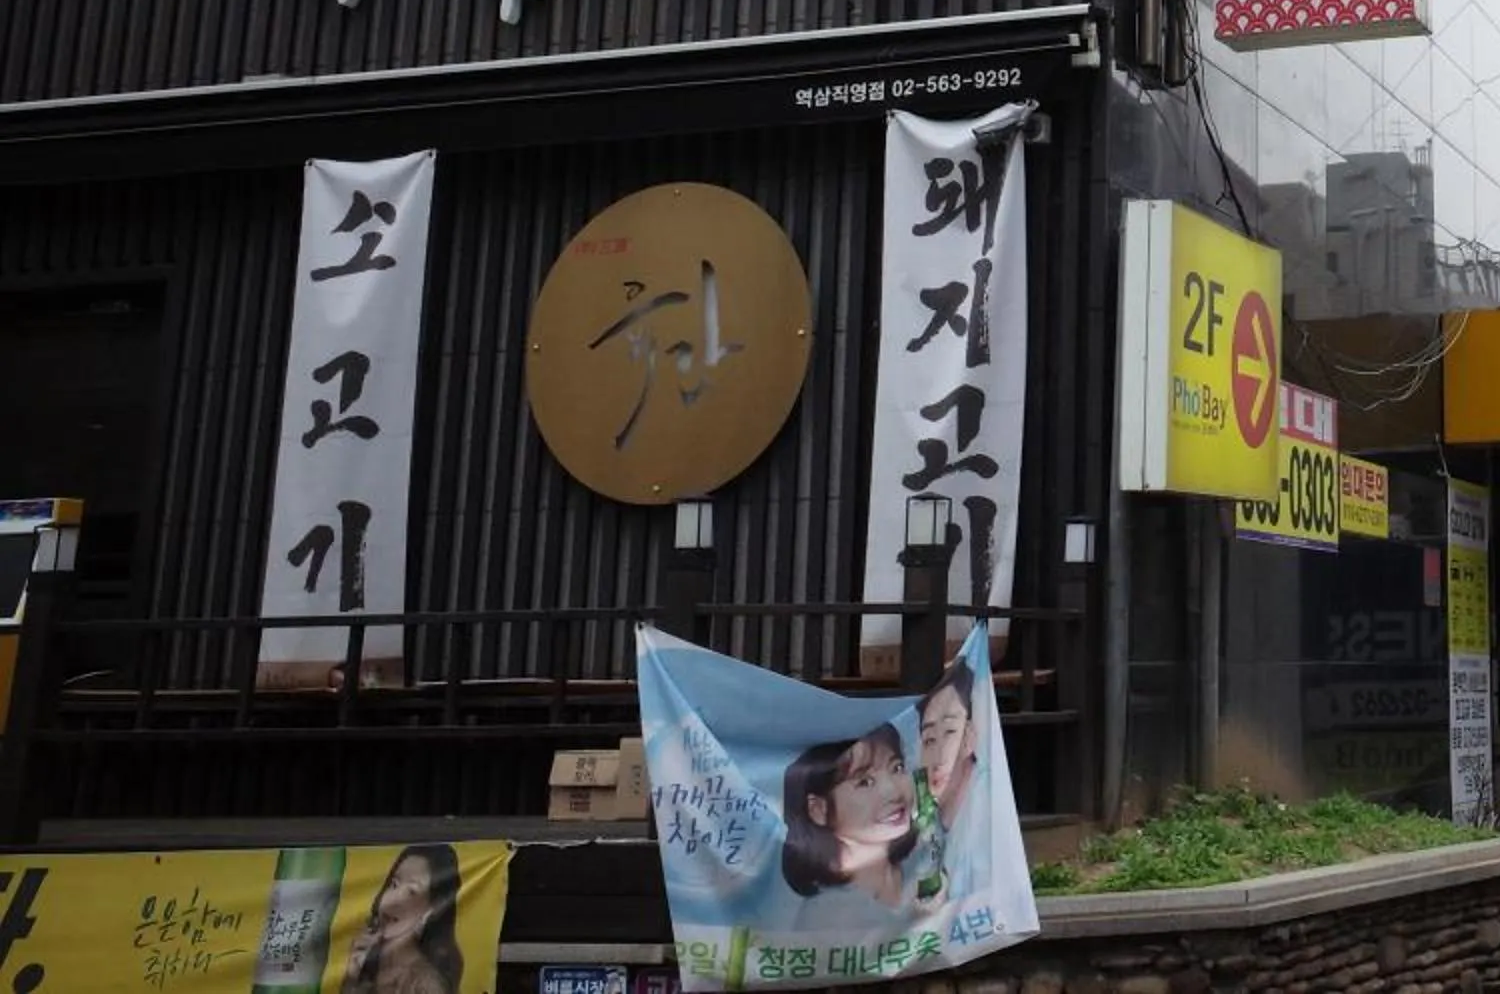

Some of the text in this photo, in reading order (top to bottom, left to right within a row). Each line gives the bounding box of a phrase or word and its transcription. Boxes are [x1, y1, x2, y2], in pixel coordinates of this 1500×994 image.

[795, 66, 1023, 108] 역삼직영점 02-563-9292
[1183, 271, 1225, 357] 2F
[286, 189, 397, 613] 소고기
[1202, 384, 1229, 430] Bay
[1341, 461, 1386, 503] 임대문의
[667, 811, 747, 865] 참이슬
[757, 943, 818, 980] 청정
